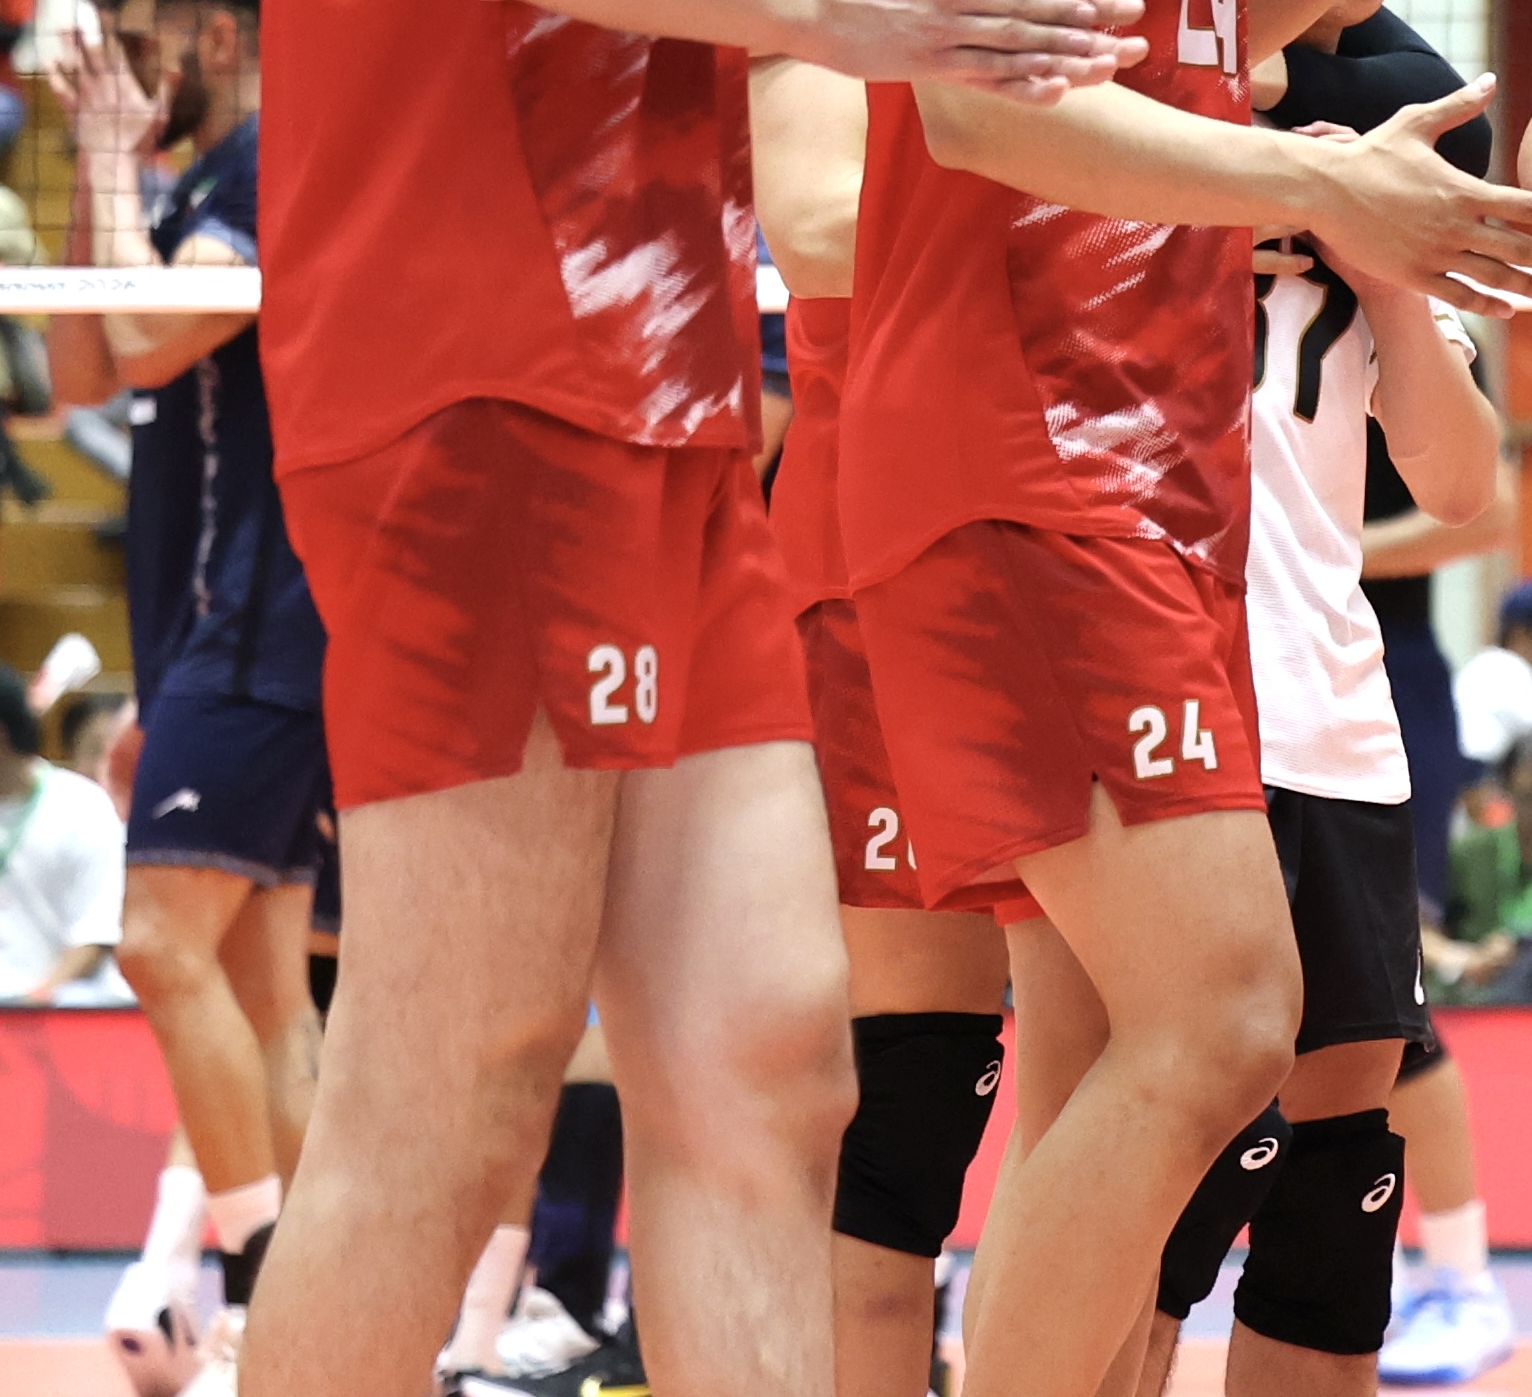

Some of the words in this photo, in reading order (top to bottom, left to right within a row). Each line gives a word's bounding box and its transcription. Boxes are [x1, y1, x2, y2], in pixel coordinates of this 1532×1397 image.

[587, 644, 658, 725] 28
[1128, 698, 1218, 780] 24
[864, 806, 917, 872] 2
